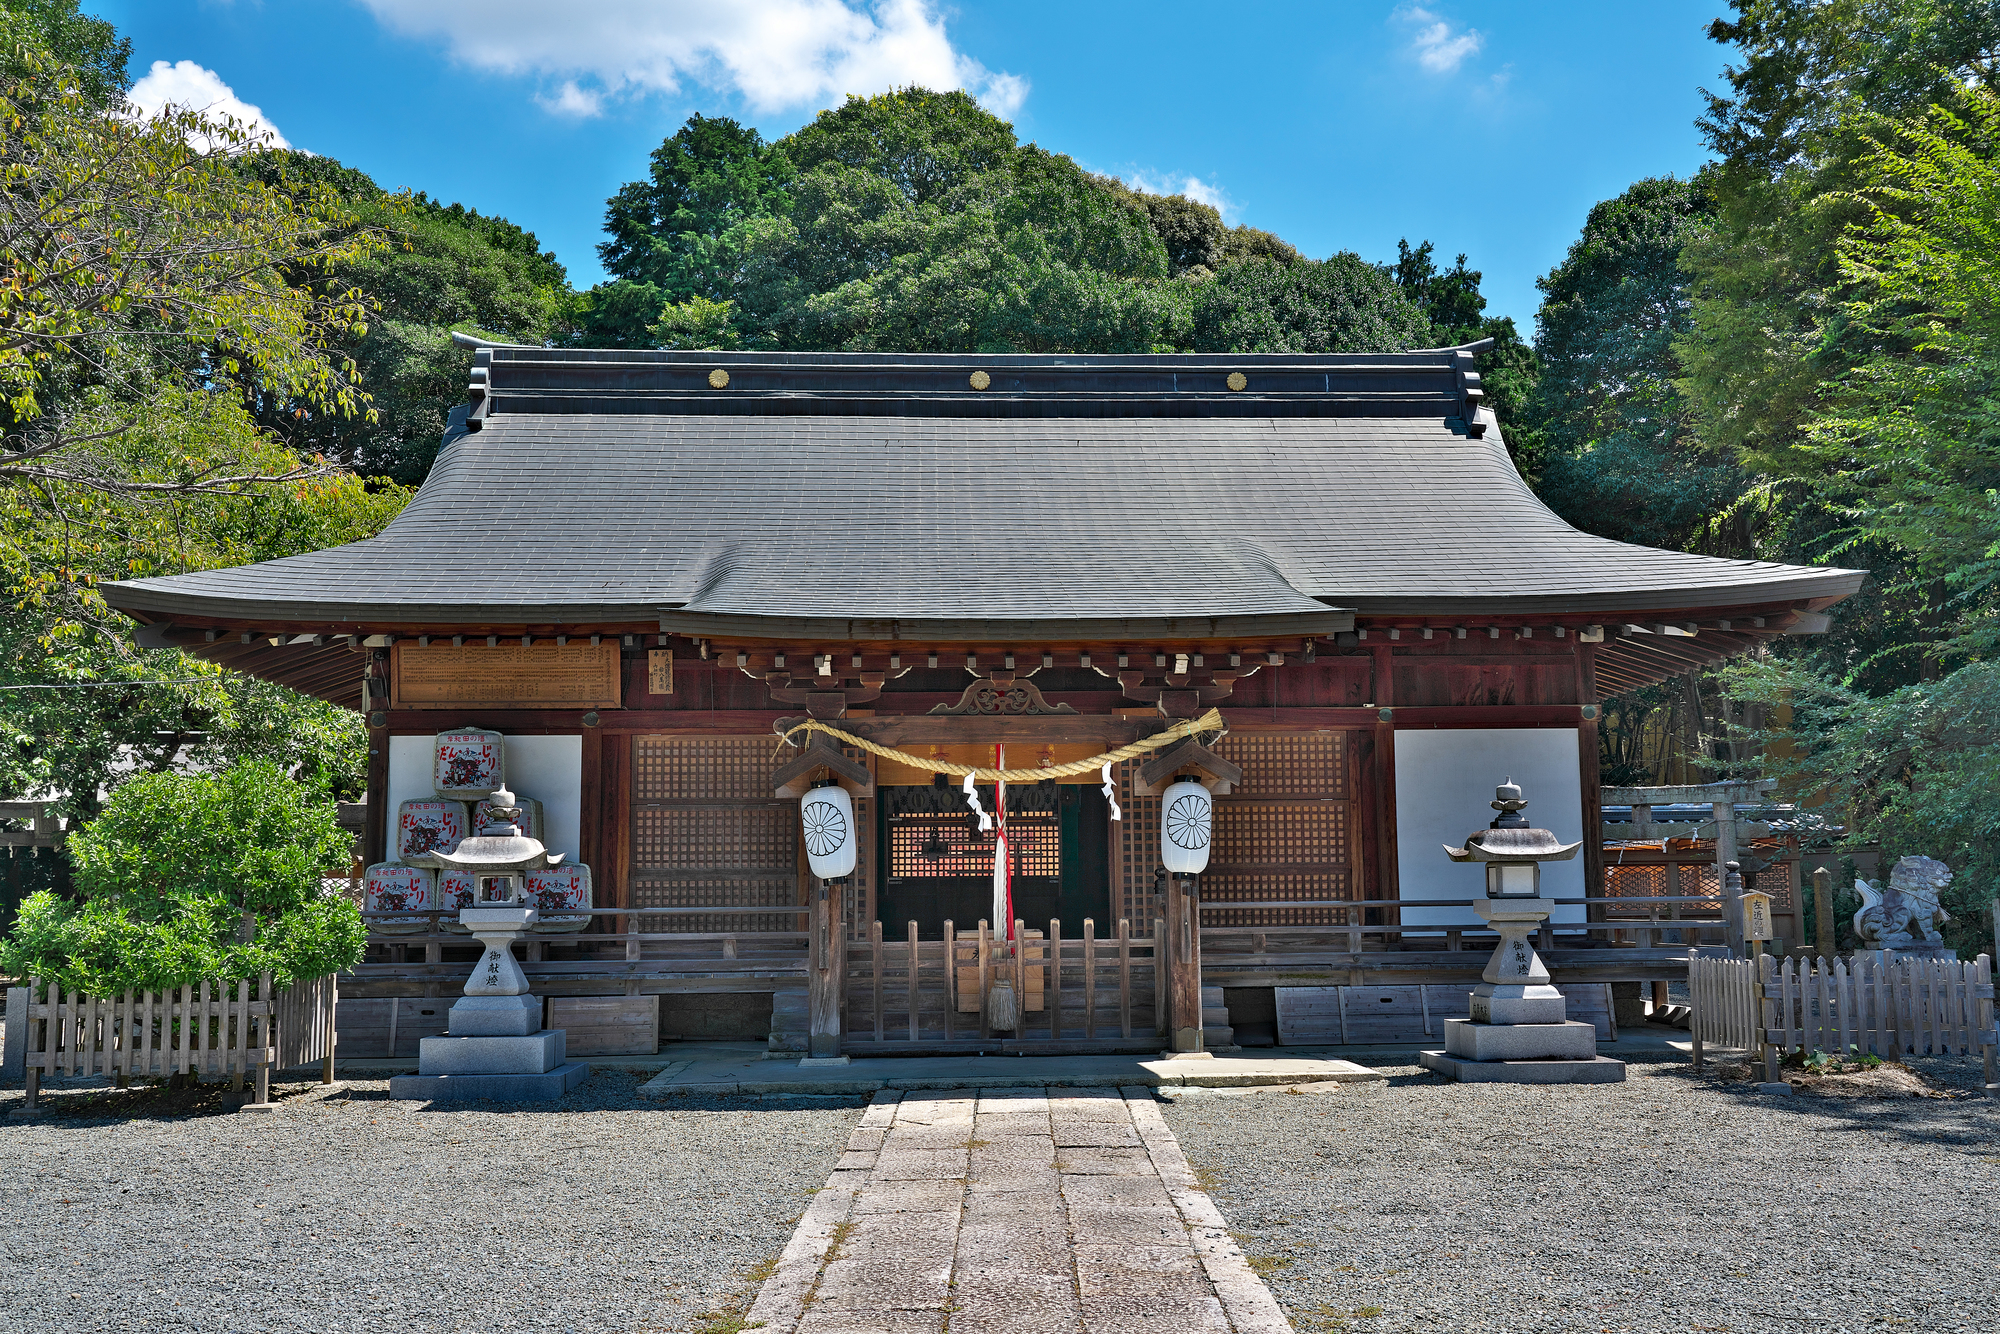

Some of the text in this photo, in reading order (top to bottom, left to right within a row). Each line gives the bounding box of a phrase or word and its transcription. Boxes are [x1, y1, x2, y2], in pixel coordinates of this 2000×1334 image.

[446, 735, 486, 743] 岸和田の酒
[408, 802, 446, 810] 岸和田の酒
[375, 868, 413, 876] 岸和田の酒
